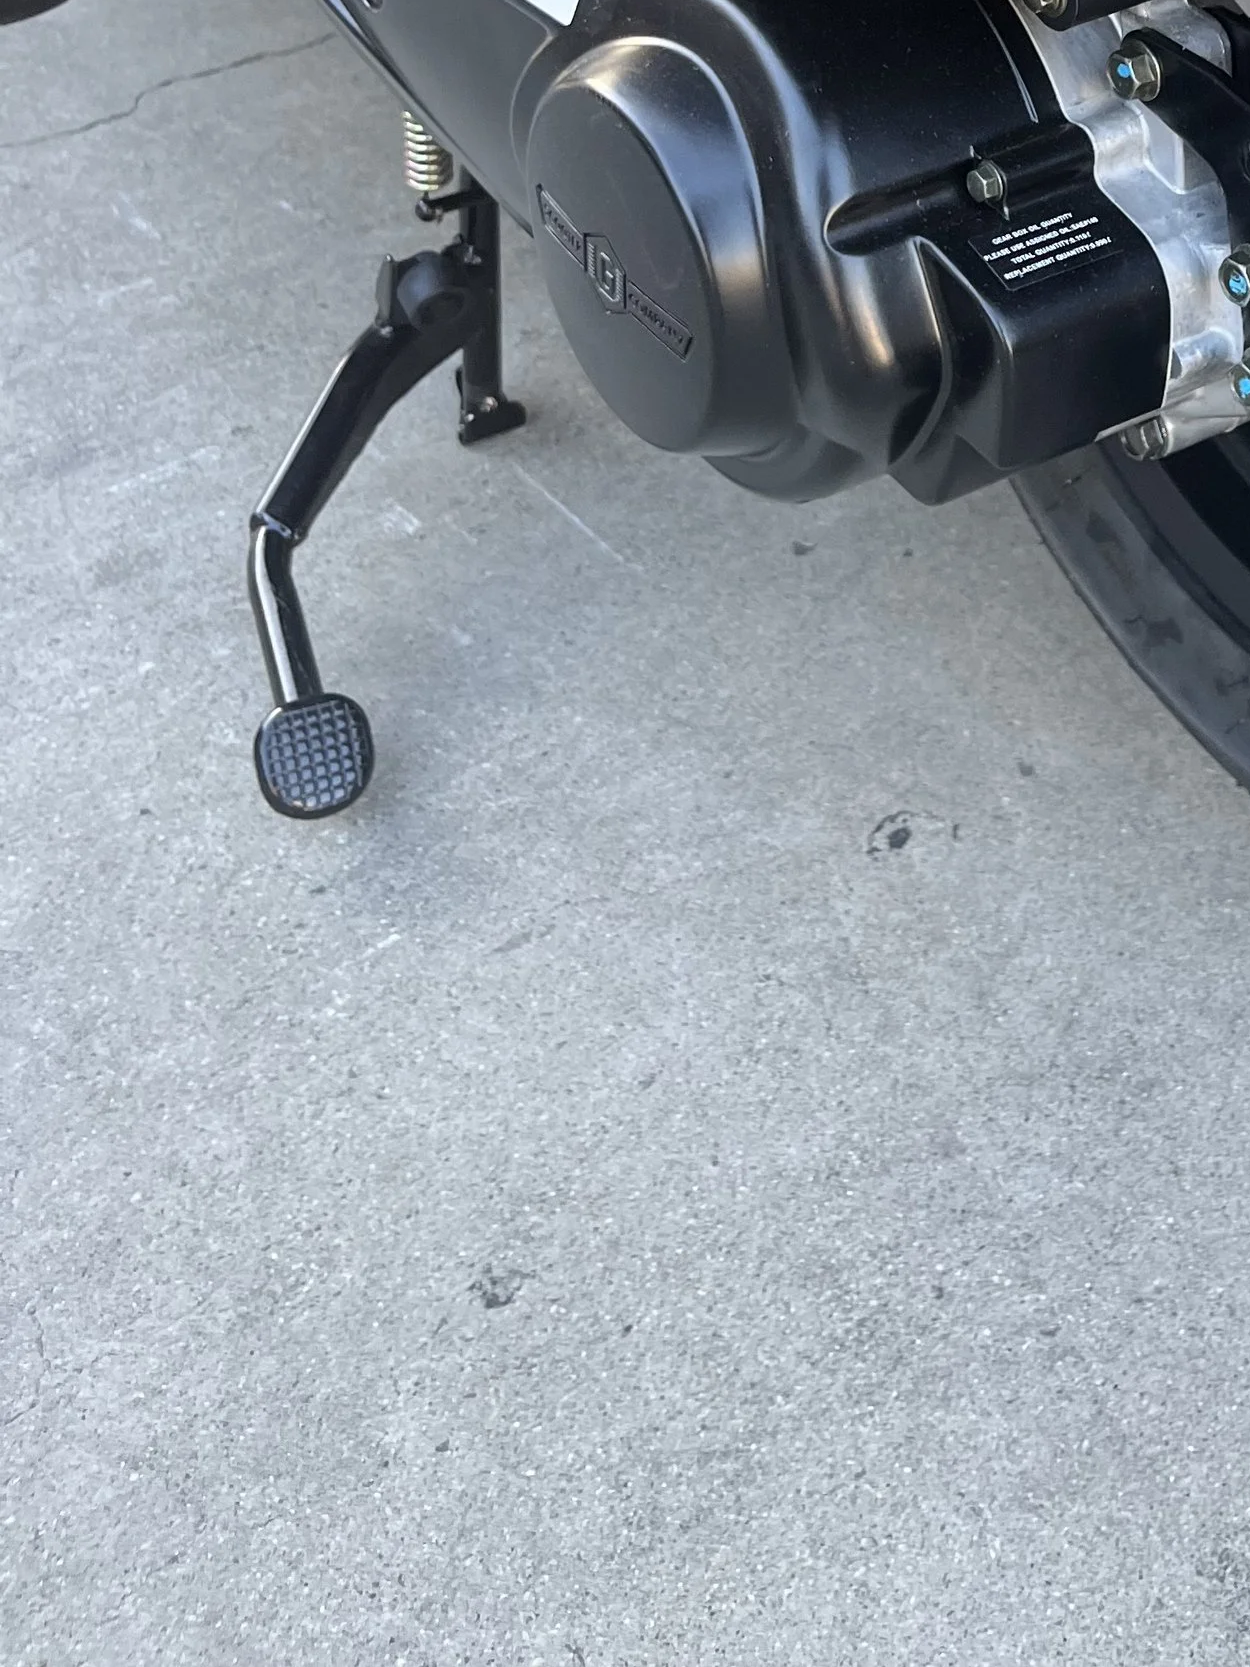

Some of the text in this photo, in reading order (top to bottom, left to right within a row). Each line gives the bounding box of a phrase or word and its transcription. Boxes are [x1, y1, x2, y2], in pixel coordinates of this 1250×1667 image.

[992, 212, 1073, 245] GEAR BOX OIL QUANTITY
[983, 247, 1011, 262] PLEASE
[1010, 242, 1026, 252] USE
[1025, 230, 1060, 247] ASSIGNED
[1010, 252, 1036, 264] TOTAL
[1003, 256, 1056, 280] REPLACEMENT
